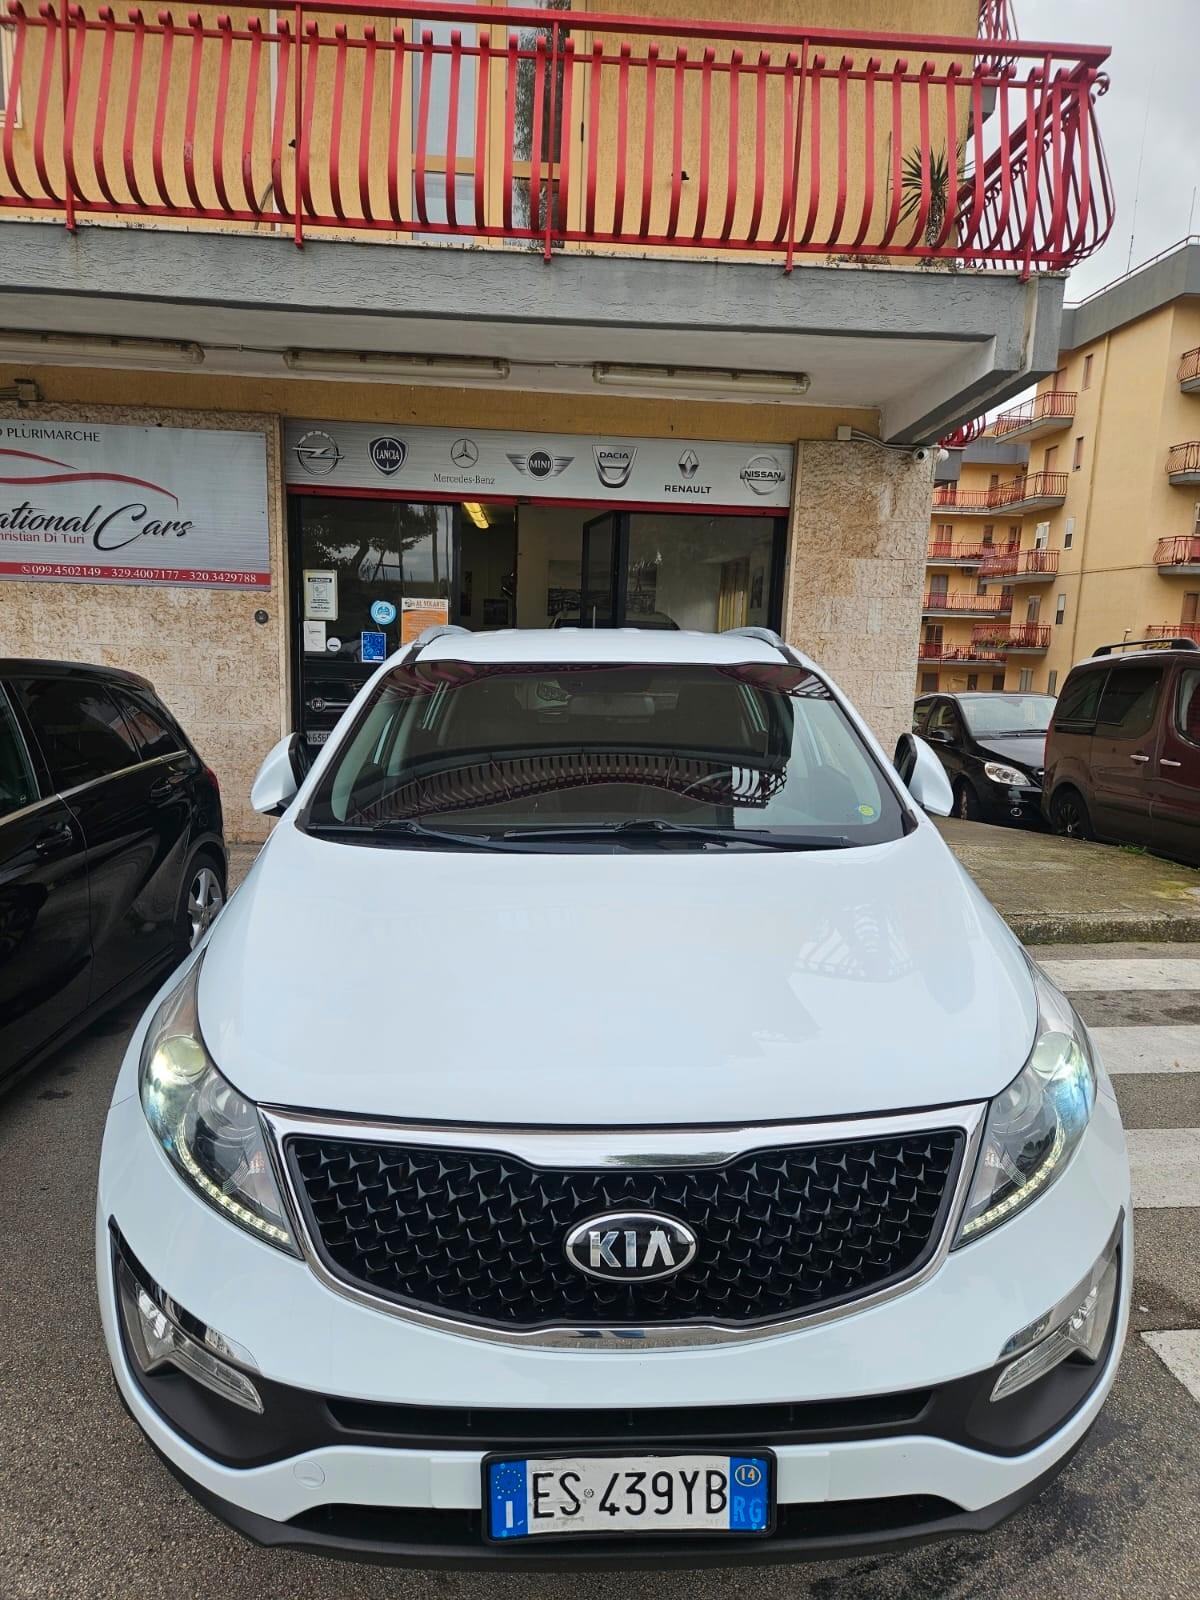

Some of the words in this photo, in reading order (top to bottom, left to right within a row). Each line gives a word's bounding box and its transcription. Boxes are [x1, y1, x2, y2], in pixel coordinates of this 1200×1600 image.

[7, 427, 101, 442] PLURIMARCHE
[376, 448, 400, 460] LANCIA
[600, 451, 629, 460] DACIA
[529, 459, 551, 469] MINI
[433, 473, 496, 485] Mercedes-Benz
[744, 469, 782, 479] NISSAN
[664, 484, 712, 494] RENAULT
[92, 503, 195, 551] Cars
[44, 533, 57, 543] Di
[61, 533, 86, 544] Turi
[31, 565, 101, 576] 099.4502149
[111, 568, 179, 580] 329.4007177
[190, 571, 257, 583] 320.3429788
[588, 1230, 676, 1268] KIA
[740, 1467, 756, 1481] 14
[531, 1471, 582, 1519] ES
[599, 1469, 728, 1517] 439YB
[733, 1495, 762, 1523] RG
